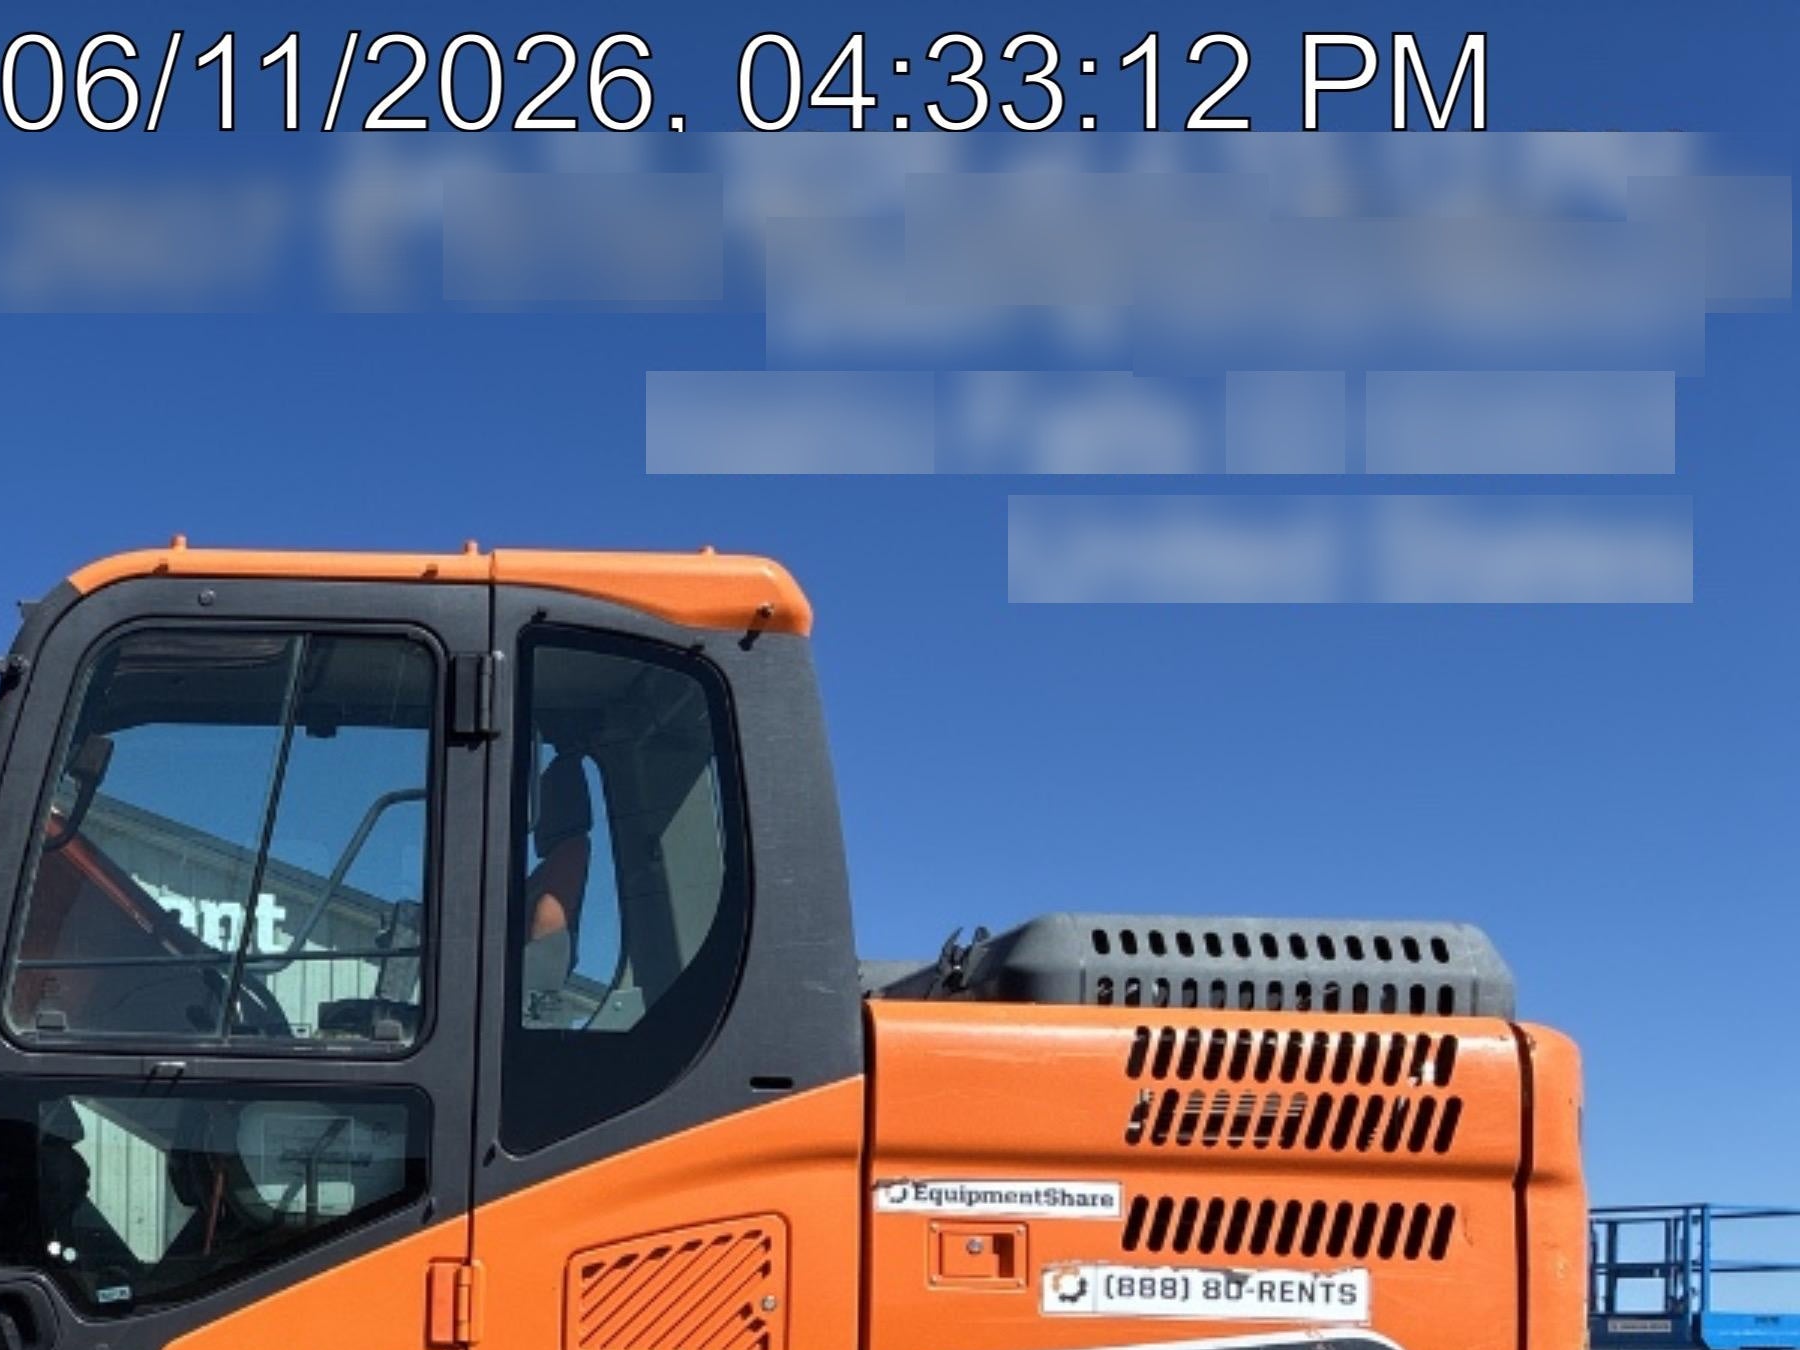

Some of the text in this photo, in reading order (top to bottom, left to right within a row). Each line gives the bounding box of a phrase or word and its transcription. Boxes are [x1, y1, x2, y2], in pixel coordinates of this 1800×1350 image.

[913, 1183, 1115, 1208] EquipmentShare
[1105, 1274, 1358, 1305] (888) 80-RENTS
